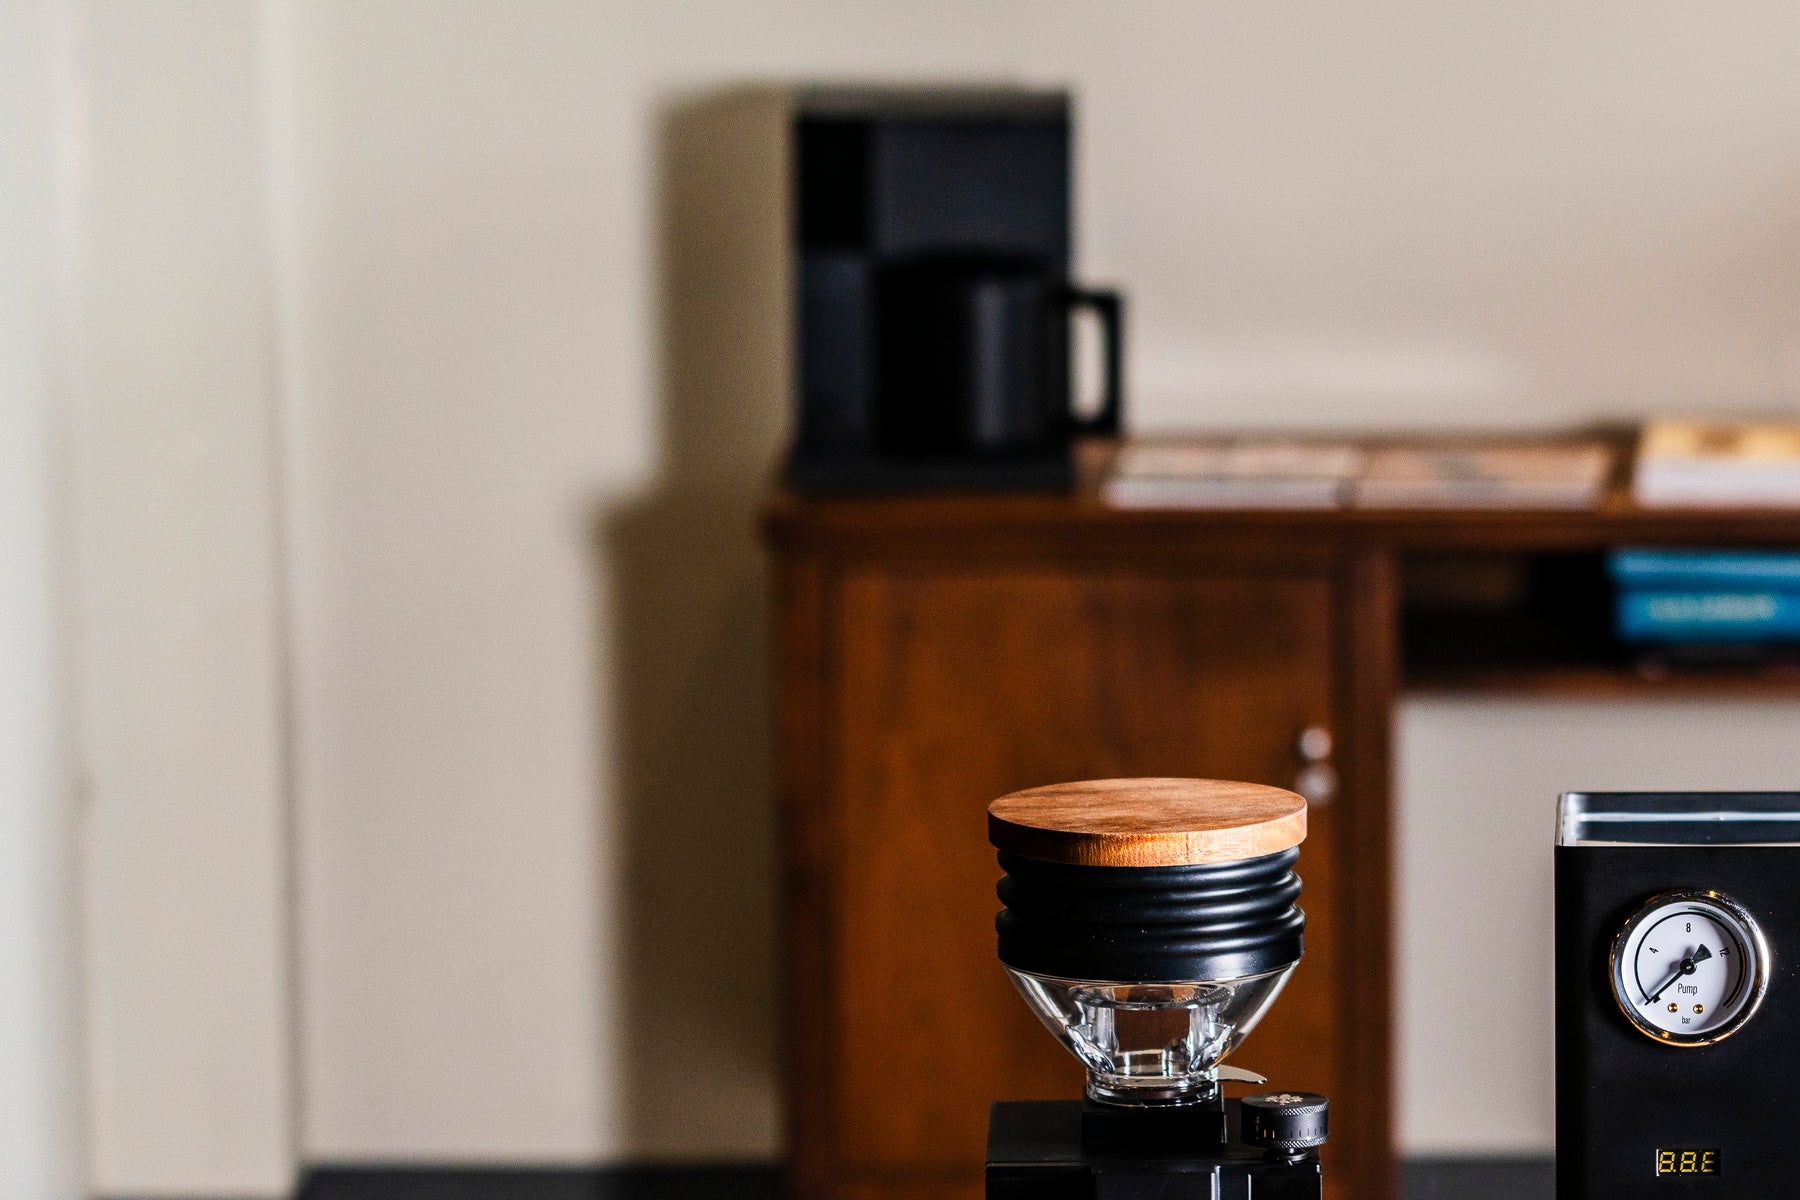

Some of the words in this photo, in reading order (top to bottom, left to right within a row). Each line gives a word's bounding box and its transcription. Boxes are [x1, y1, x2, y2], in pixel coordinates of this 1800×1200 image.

[1685, 922, 1692, 933] 8
[1648, 946, 1659, 955] 4
[1719, 947, 1730, 958] 12
[1677, 983, 1698, 996] Pump
[1681, 1016, 1691, 1024] bar
